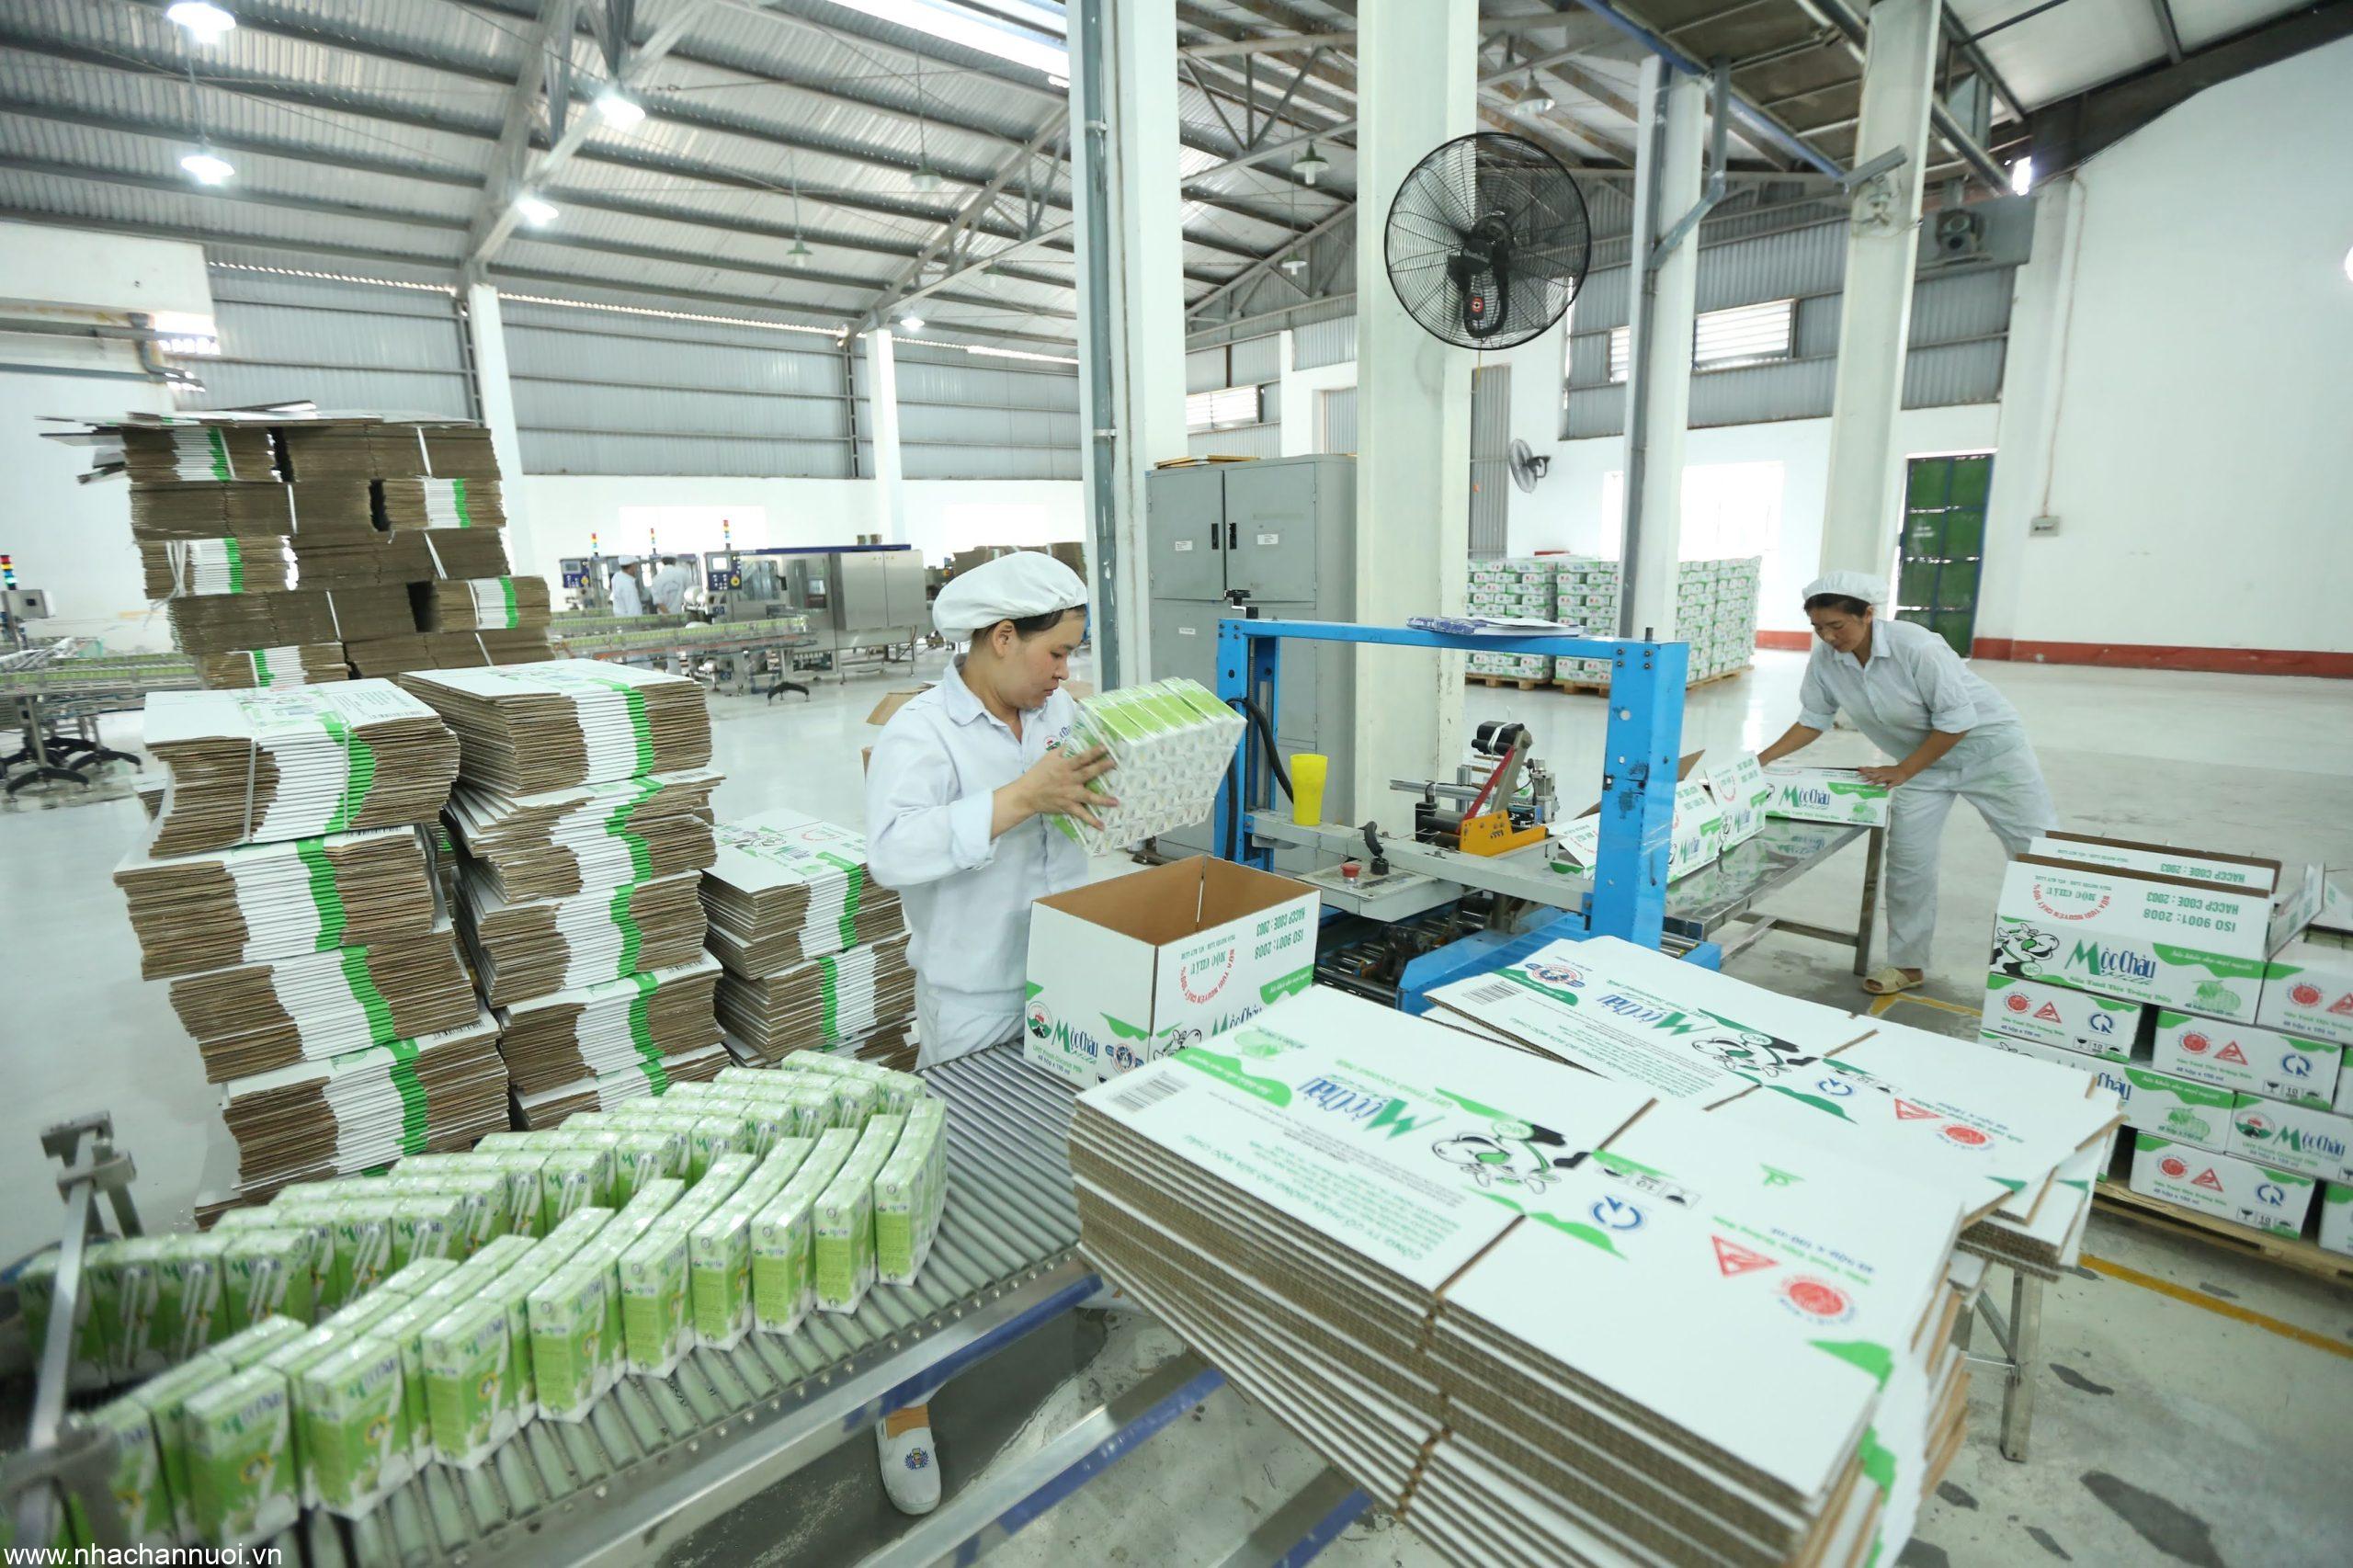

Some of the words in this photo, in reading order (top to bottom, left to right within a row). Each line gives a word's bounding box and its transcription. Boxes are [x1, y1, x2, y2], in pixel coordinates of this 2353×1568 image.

[2188, 867, 2213, 880] CODE
[2214, 871, 2245, 883] HACCP
[2146, 892, 2169, 904] 2003
[2177, 897, 2203, 910] CODE
[1290, 906, 1306, 924] HACCP
[2143, 908, 2173, 923] 2008
[2206, 903, 2239, 915] HACCP
[1274, 914, 1289, 930] CODE
[2215, 919, 2236, 933] ISO
[1293, 928, 1304, 944] ISO
[1255, 941, 1271, 960] 2008
